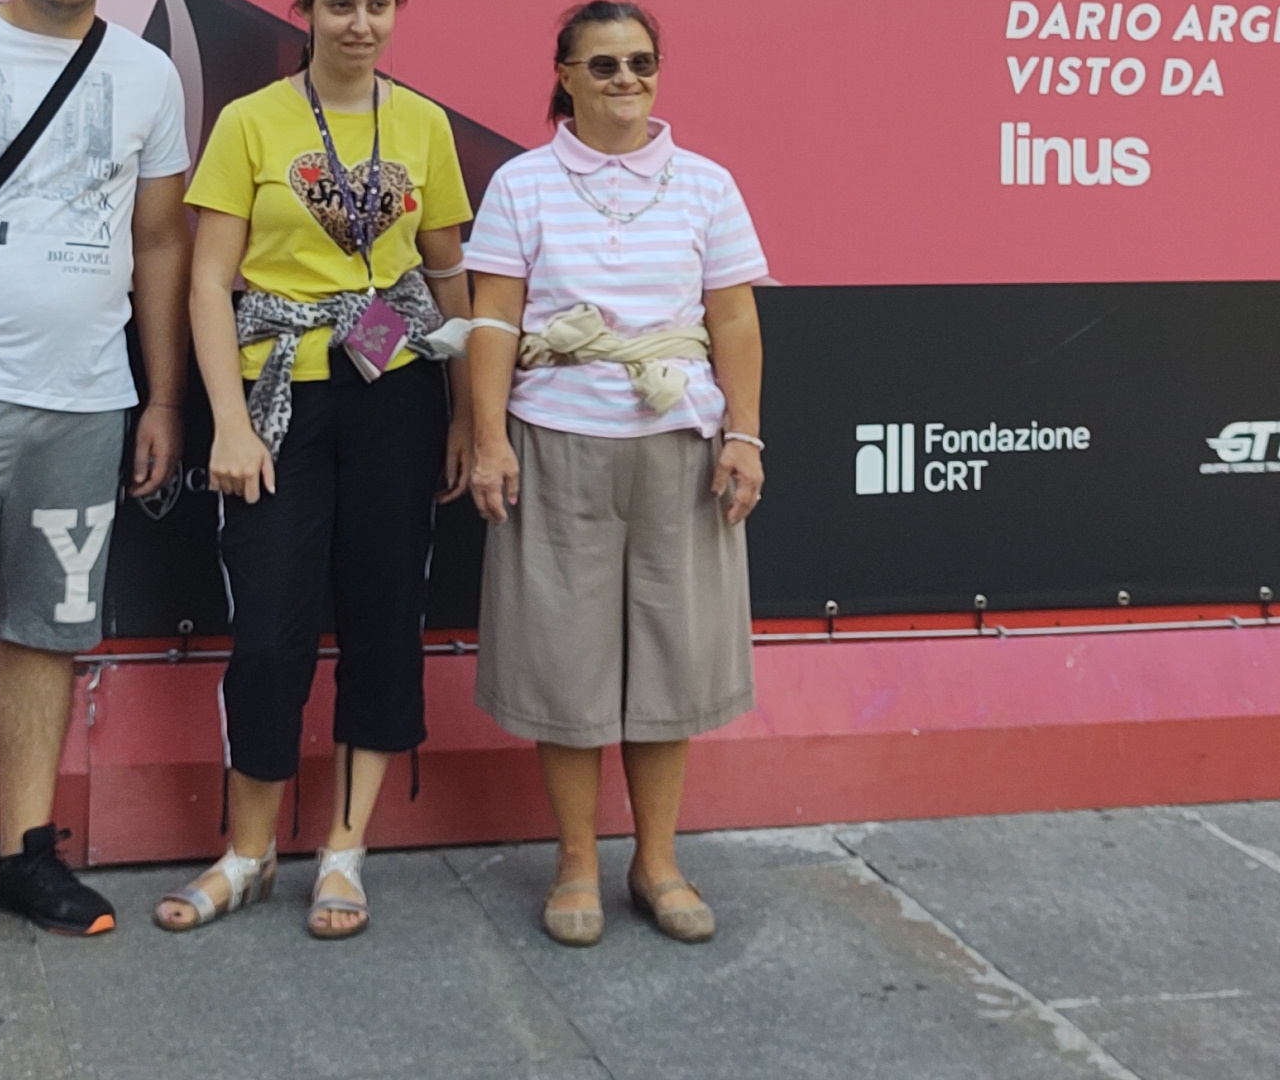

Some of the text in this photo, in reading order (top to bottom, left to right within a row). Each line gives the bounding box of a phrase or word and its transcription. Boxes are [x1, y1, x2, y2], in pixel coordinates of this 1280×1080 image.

[1005, 1, 1162, 41] DARIO
[1006, 56, 1224, 96] VISTO DA
[1000, 122, 1151, 187] linus
[925, 420, 1091, 454] Fondazione
[924, 459, 989, 493] CRT
